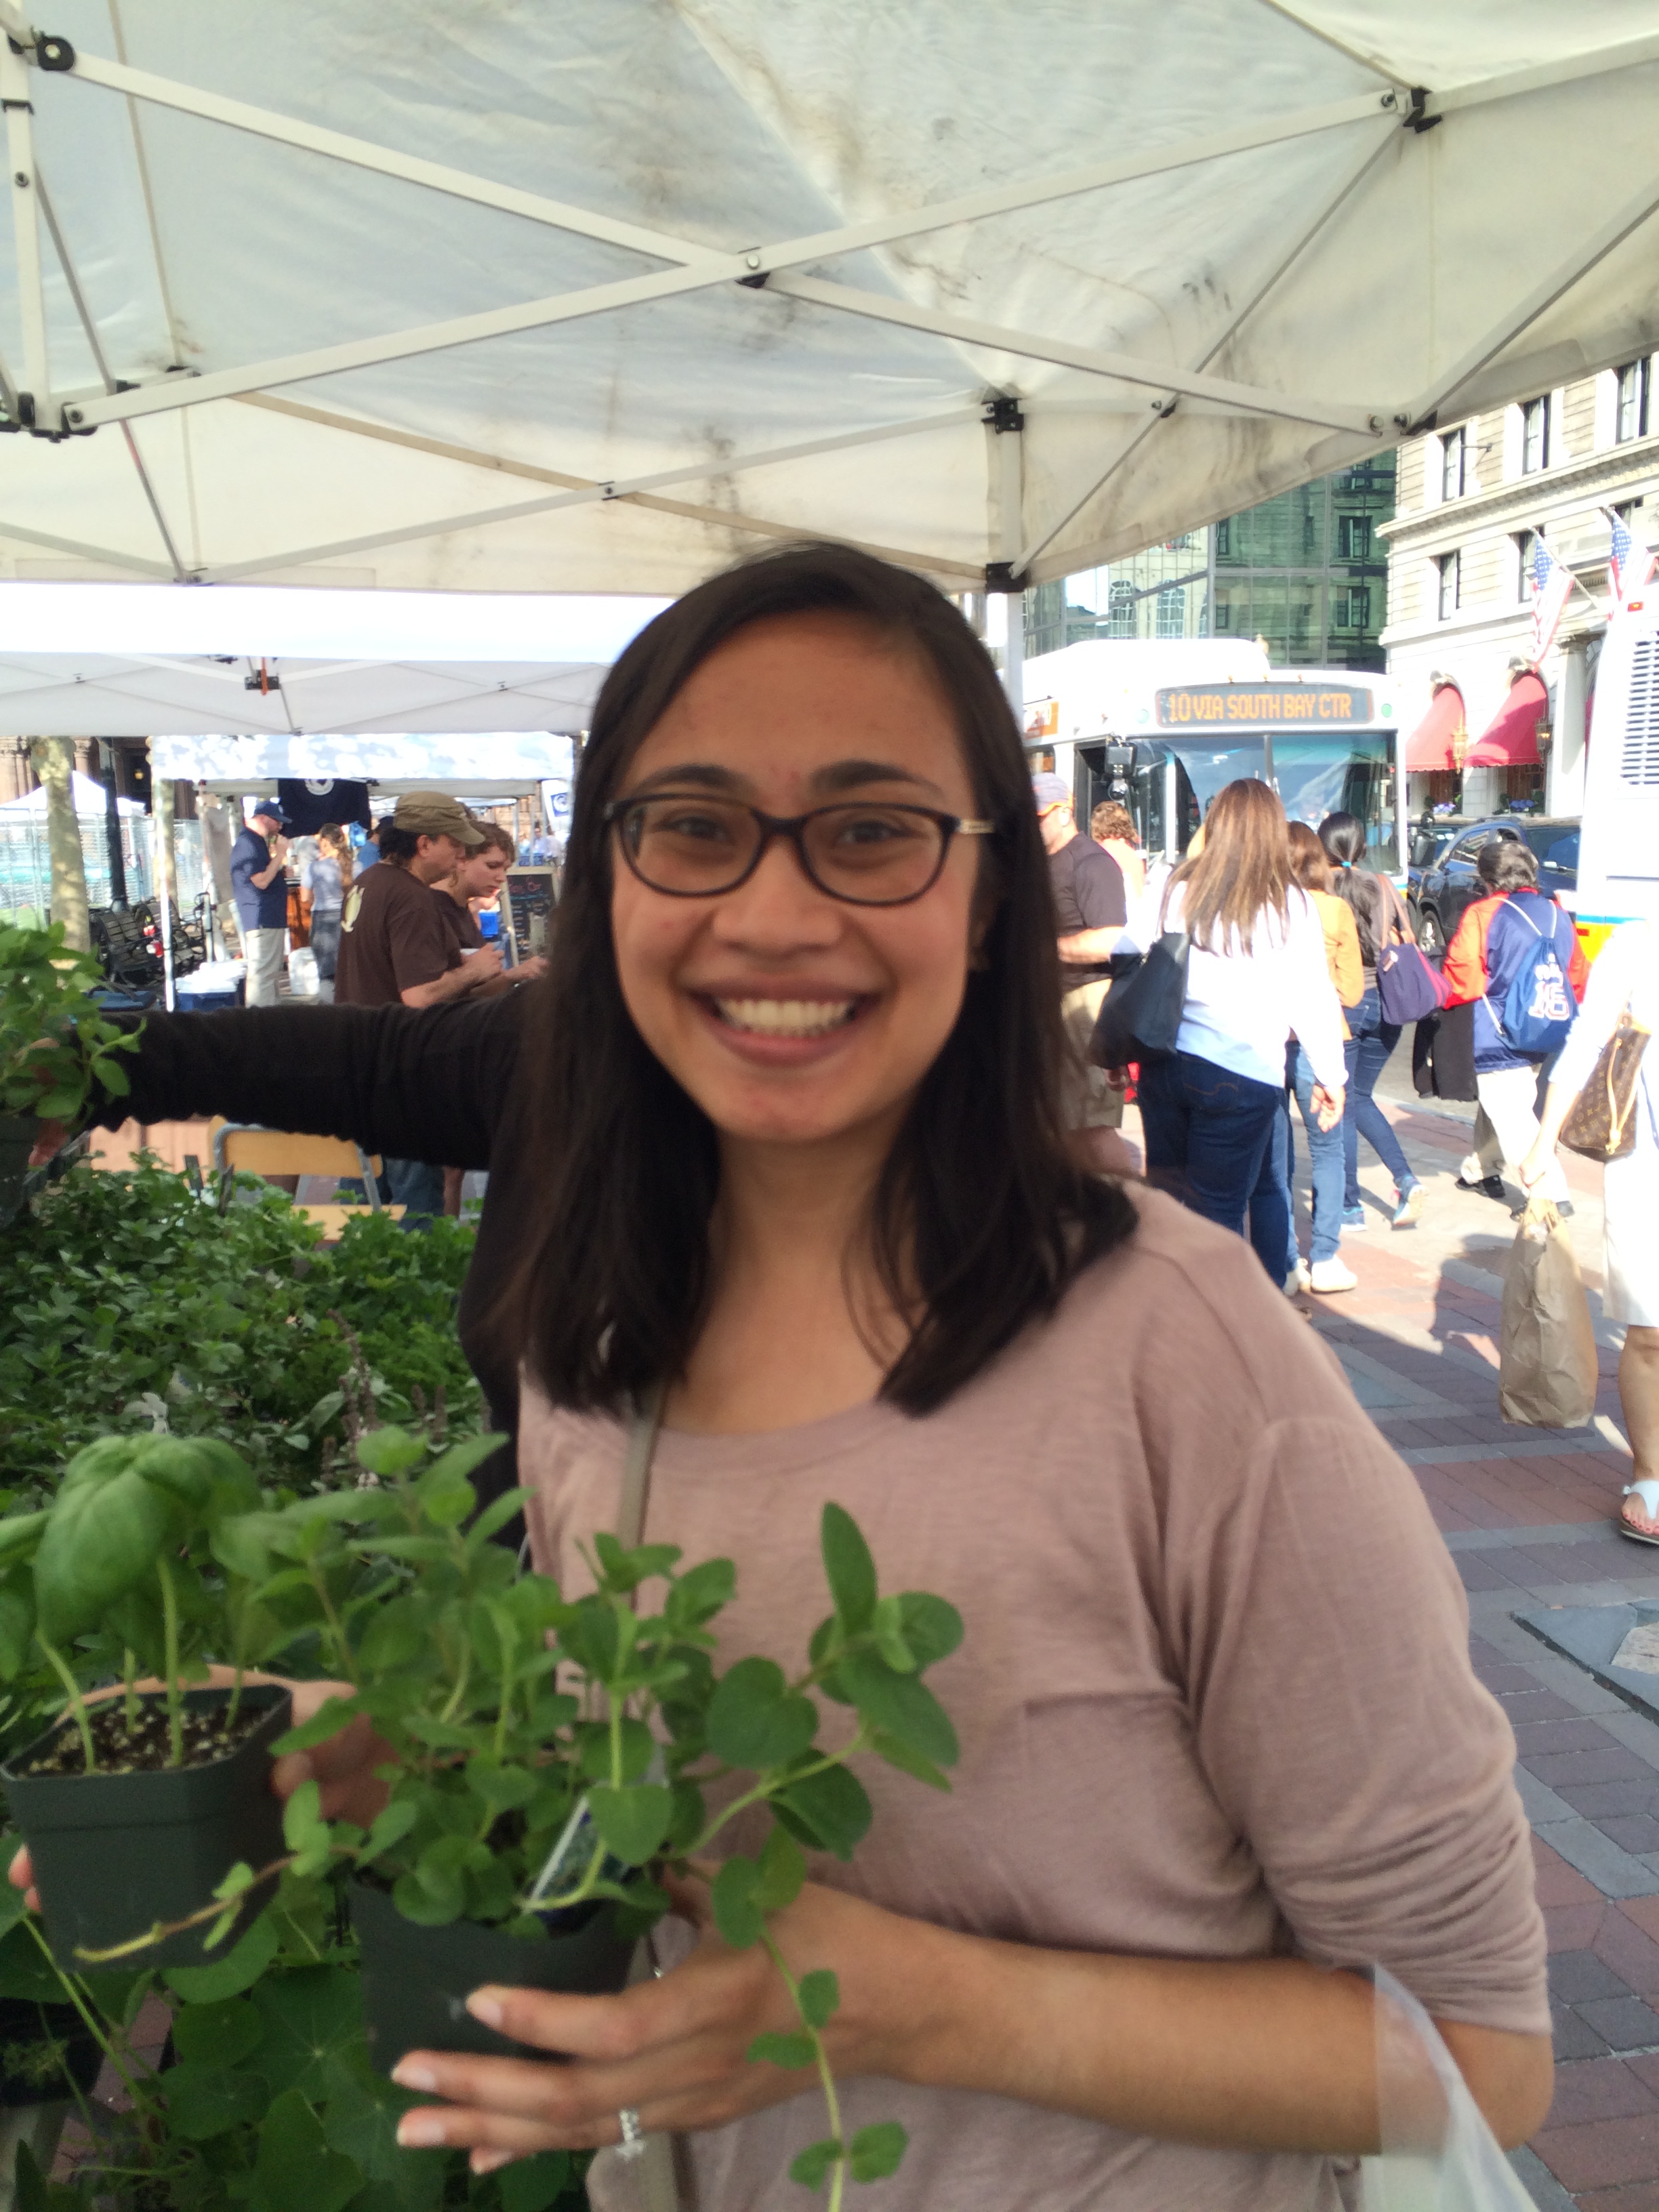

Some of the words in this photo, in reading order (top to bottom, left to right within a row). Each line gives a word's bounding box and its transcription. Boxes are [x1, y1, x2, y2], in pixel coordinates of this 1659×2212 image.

[1168, 693, 1191, 722] 10
[1193, 694, 1224, 720] VIA
[1227, 693, 1281, 719] SOUTH
[1284, 693, 1316, 718] BAY
[1318, 693, 1352, 718] CTR
